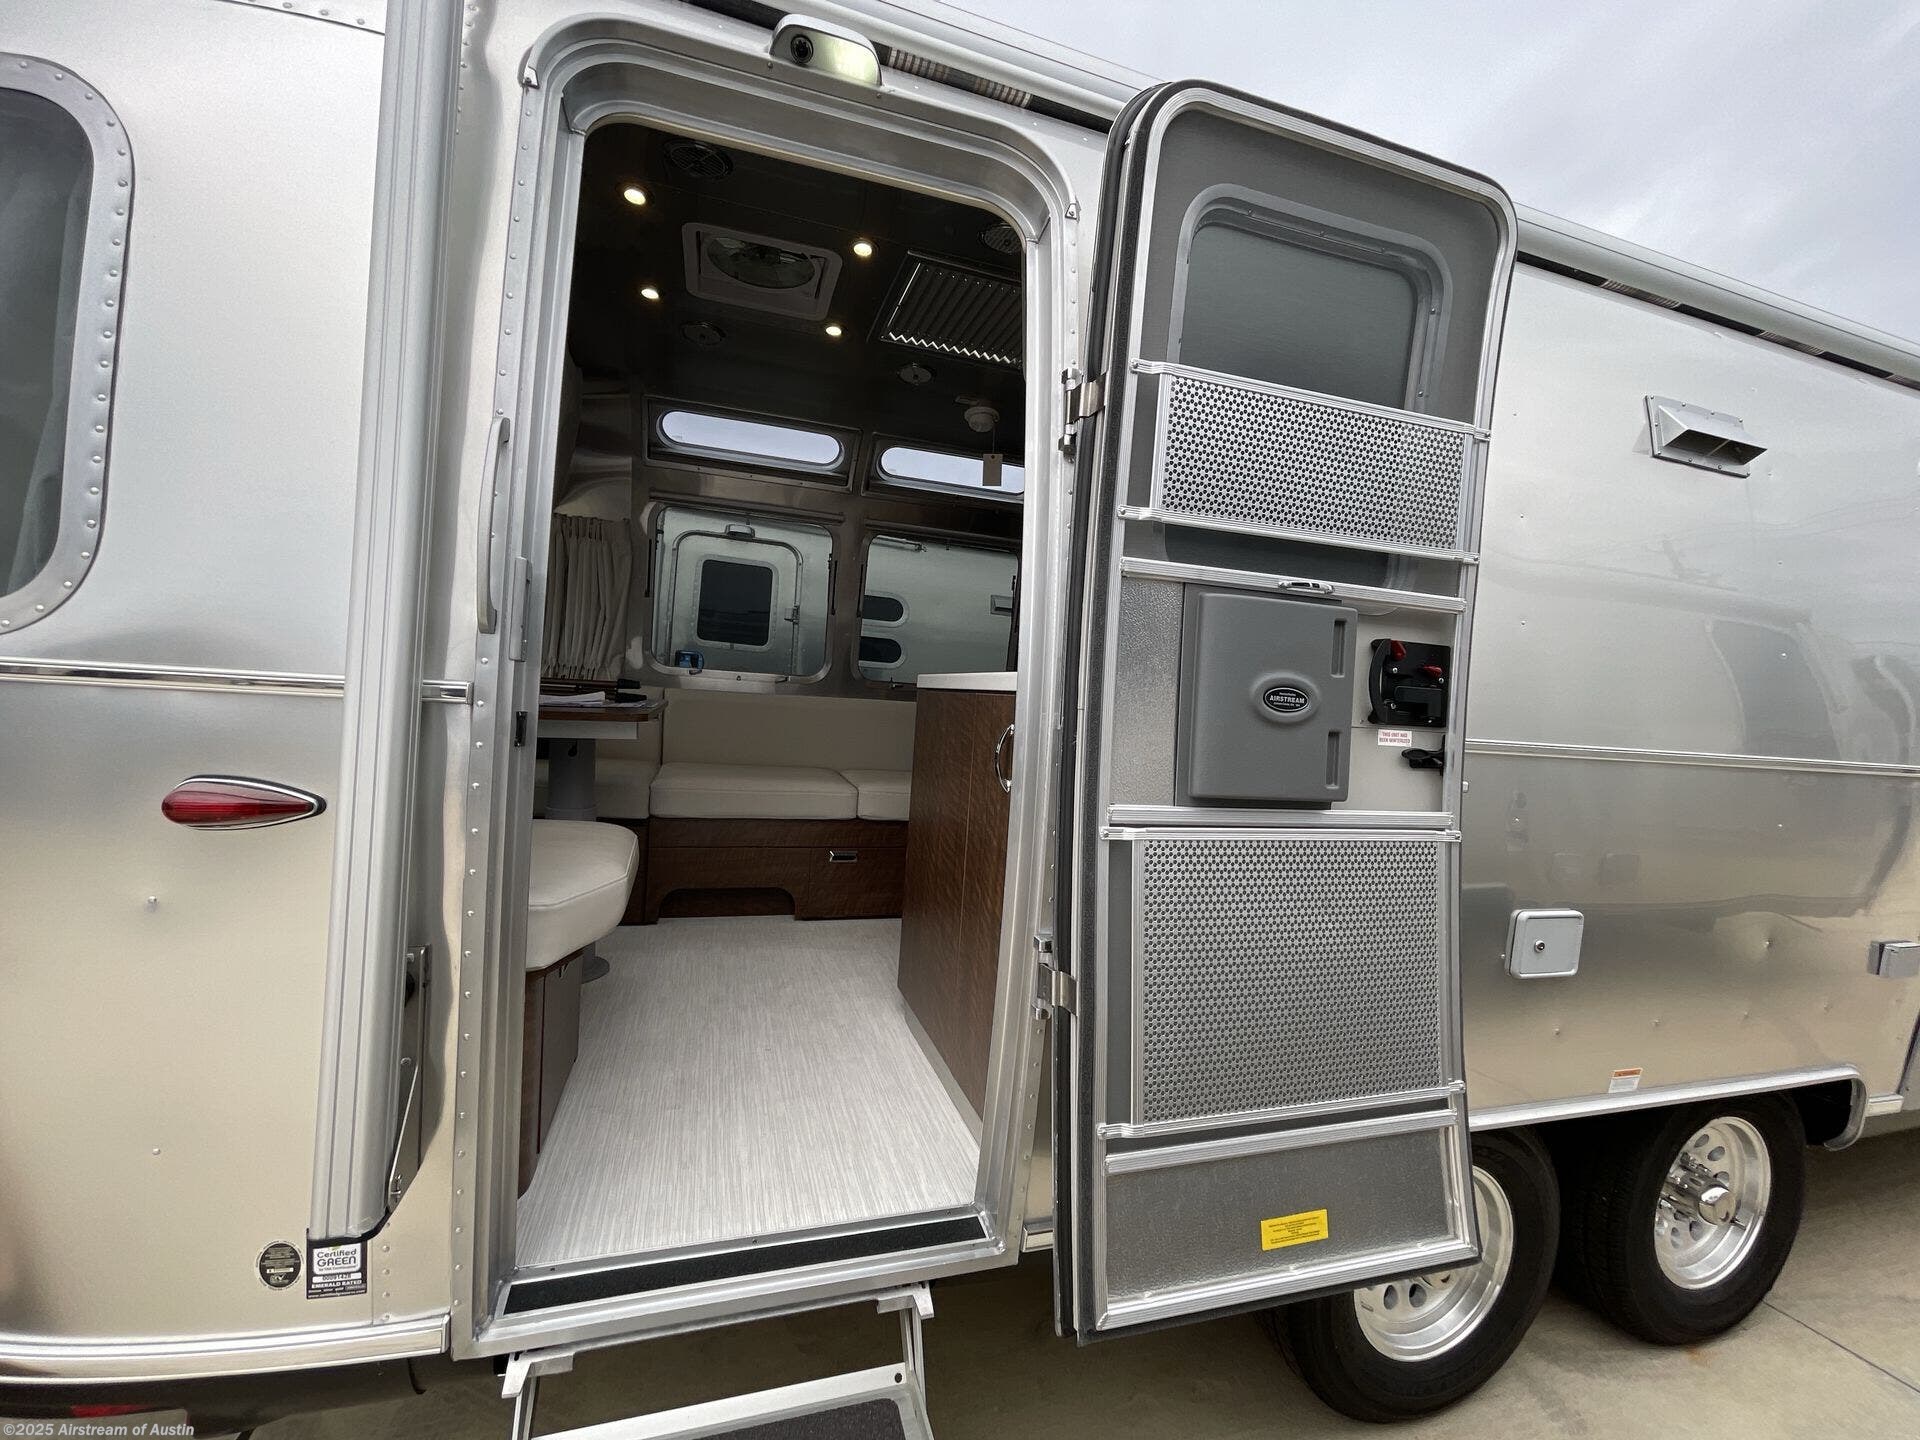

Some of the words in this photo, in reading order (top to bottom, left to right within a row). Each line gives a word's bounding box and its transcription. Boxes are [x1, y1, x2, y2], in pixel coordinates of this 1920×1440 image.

[1269, 695, 1305, 704] AIRSTREAM
[316, 1248, 357, 1259] Certified
[317, 1256, 357, 1267] GREEN
[311, 1281, 341, 1289] EMERALD
